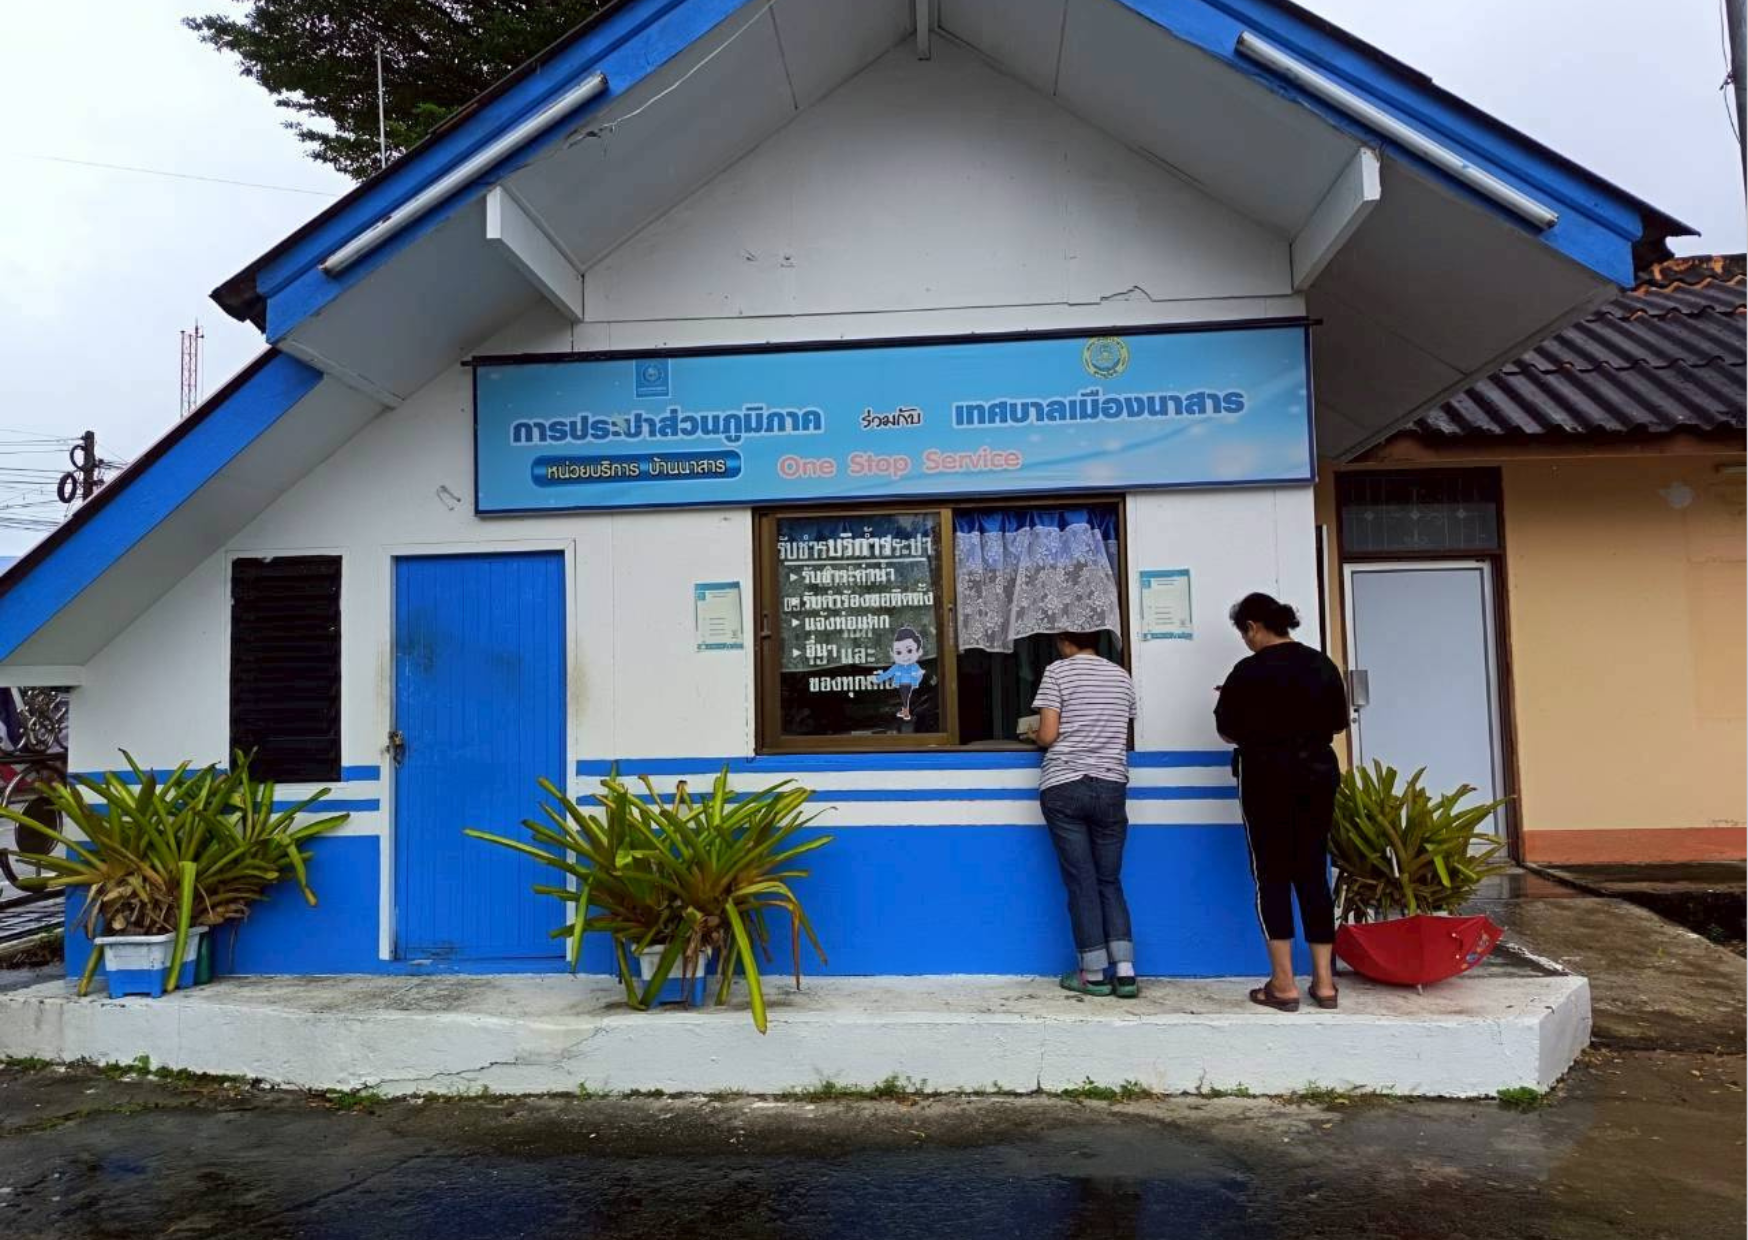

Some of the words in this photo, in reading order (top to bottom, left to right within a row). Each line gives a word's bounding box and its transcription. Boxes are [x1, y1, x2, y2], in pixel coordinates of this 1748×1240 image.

[861, 406, 923, 429] ร่วมกับ
[954, 389, 1246, 427] เทศบาลเมืองนาสาร
[513, 406, 823, 445] การประปาส่วนภูมิภาค
[546, 456, 640, 480] หน่วยบริการ
[649, 454, 726, 478] บ้านนาสาร
[778, 454, 835, 479] One
[848, 451, 910, 478] Stop
[923, 447, 1022, 473] Service
